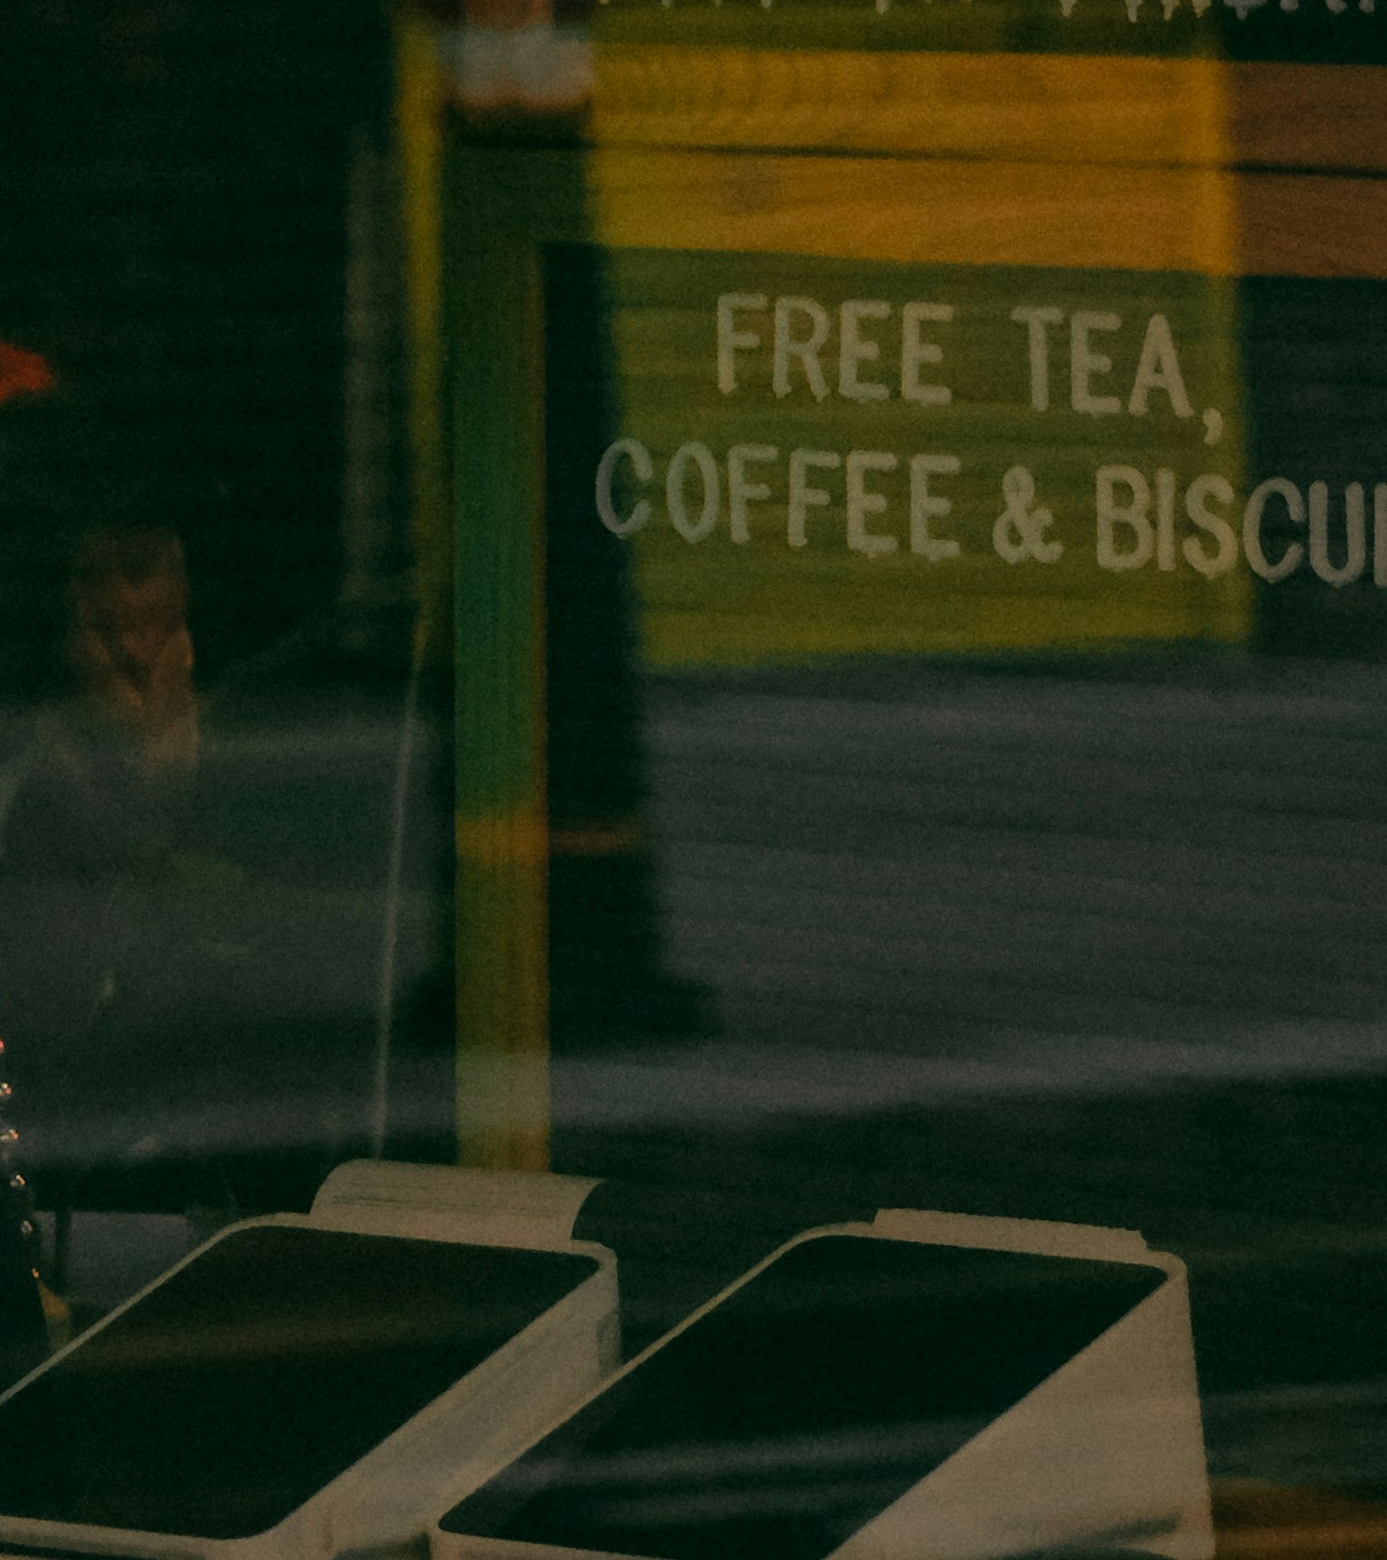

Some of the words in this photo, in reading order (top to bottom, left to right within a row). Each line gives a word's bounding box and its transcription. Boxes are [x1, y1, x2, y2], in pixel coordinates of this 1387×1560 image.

[713, 293, 952, 406] FREE
[1010, 305, 1223, 444] TEA,
[595, 438, 960, 561] COFFEE
[990, 468, 1065, 564] &
